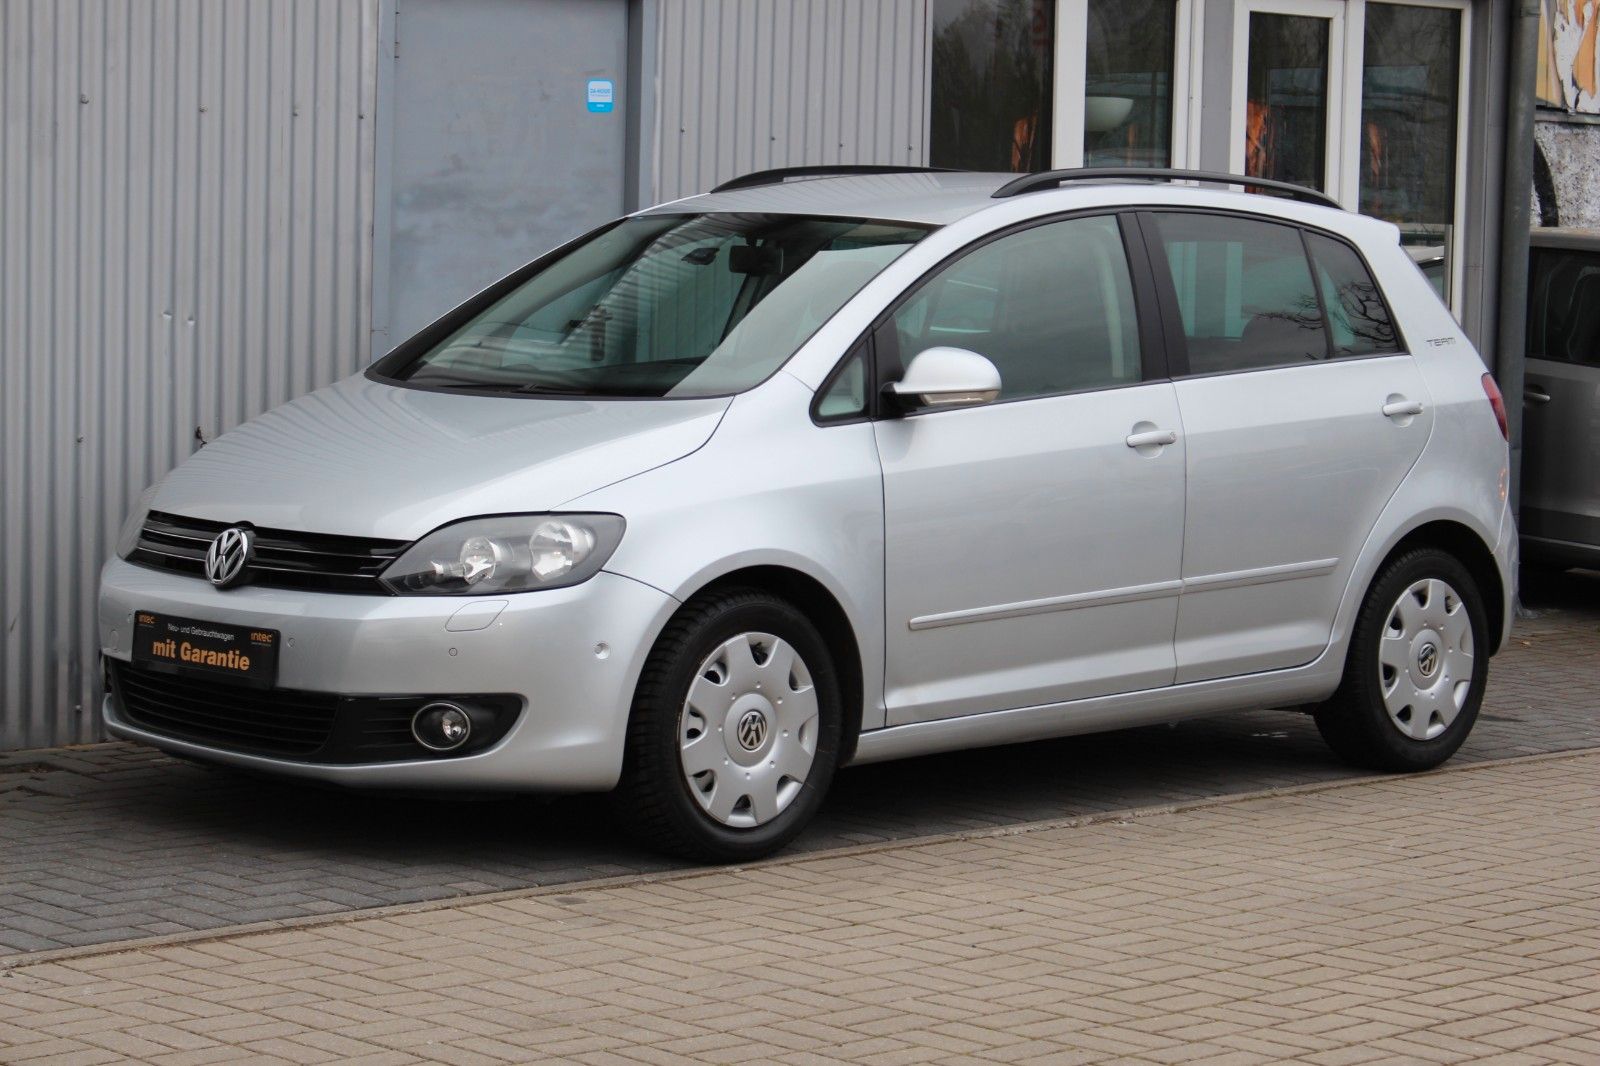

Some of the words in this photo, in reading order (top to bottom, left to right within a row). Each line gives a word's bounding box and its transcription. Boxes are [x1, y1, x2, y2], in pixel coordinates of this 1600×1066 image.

[181, 626, 191, 634] und
[191, 626, 235, 642] Gebrauchtwagen
[152, 639, 176, 659] mit
[180, 642, 250, 671] Garantie
